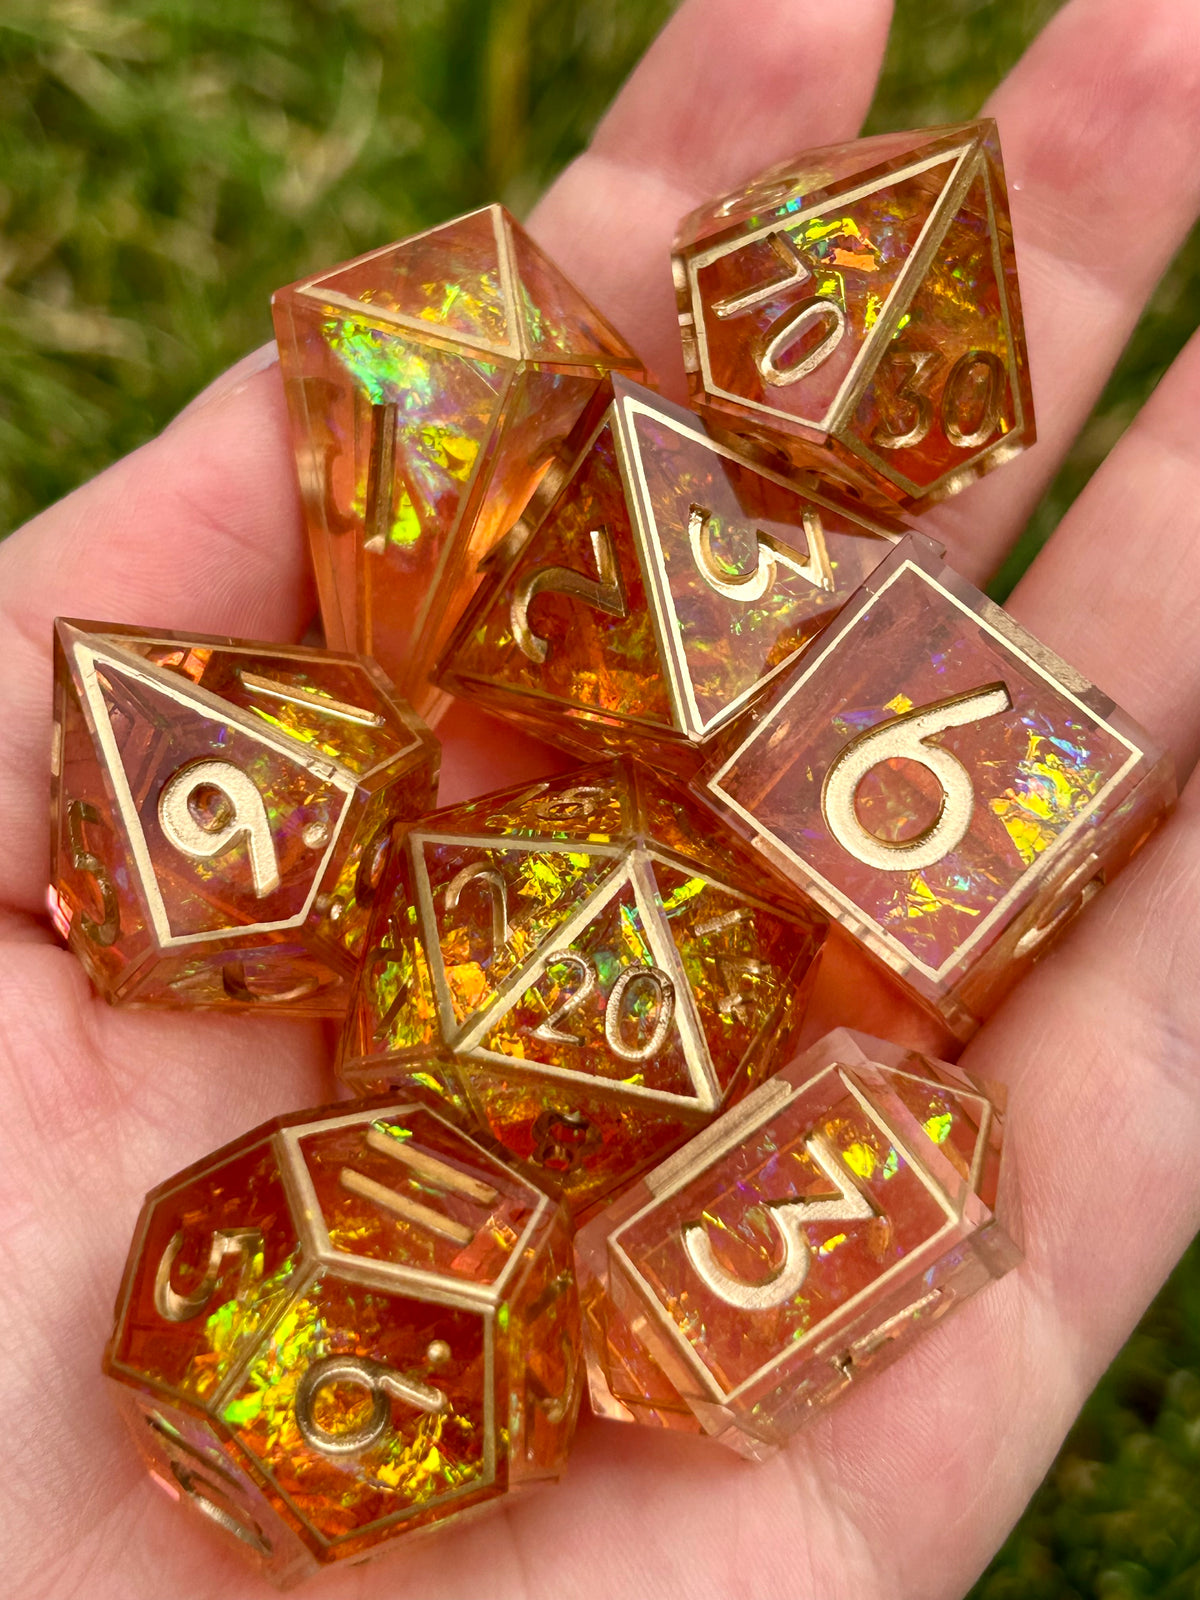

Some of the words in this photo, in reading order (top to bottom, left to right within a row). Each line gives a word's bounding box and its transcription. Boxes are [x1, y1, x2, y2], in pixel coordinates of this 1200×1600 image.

[871, 350, 1007, 449] 30
[510, 524, 628, 664] 2
[688, 502, 836, 602] 3
[820, 680, 1014, 872] 6
[531, 949, 677, 1063] 20
[338, 1129, 500, 1245] 11
[682, 1133, 890, 1311] 3
[154, 1226, 264, 1323] 5
